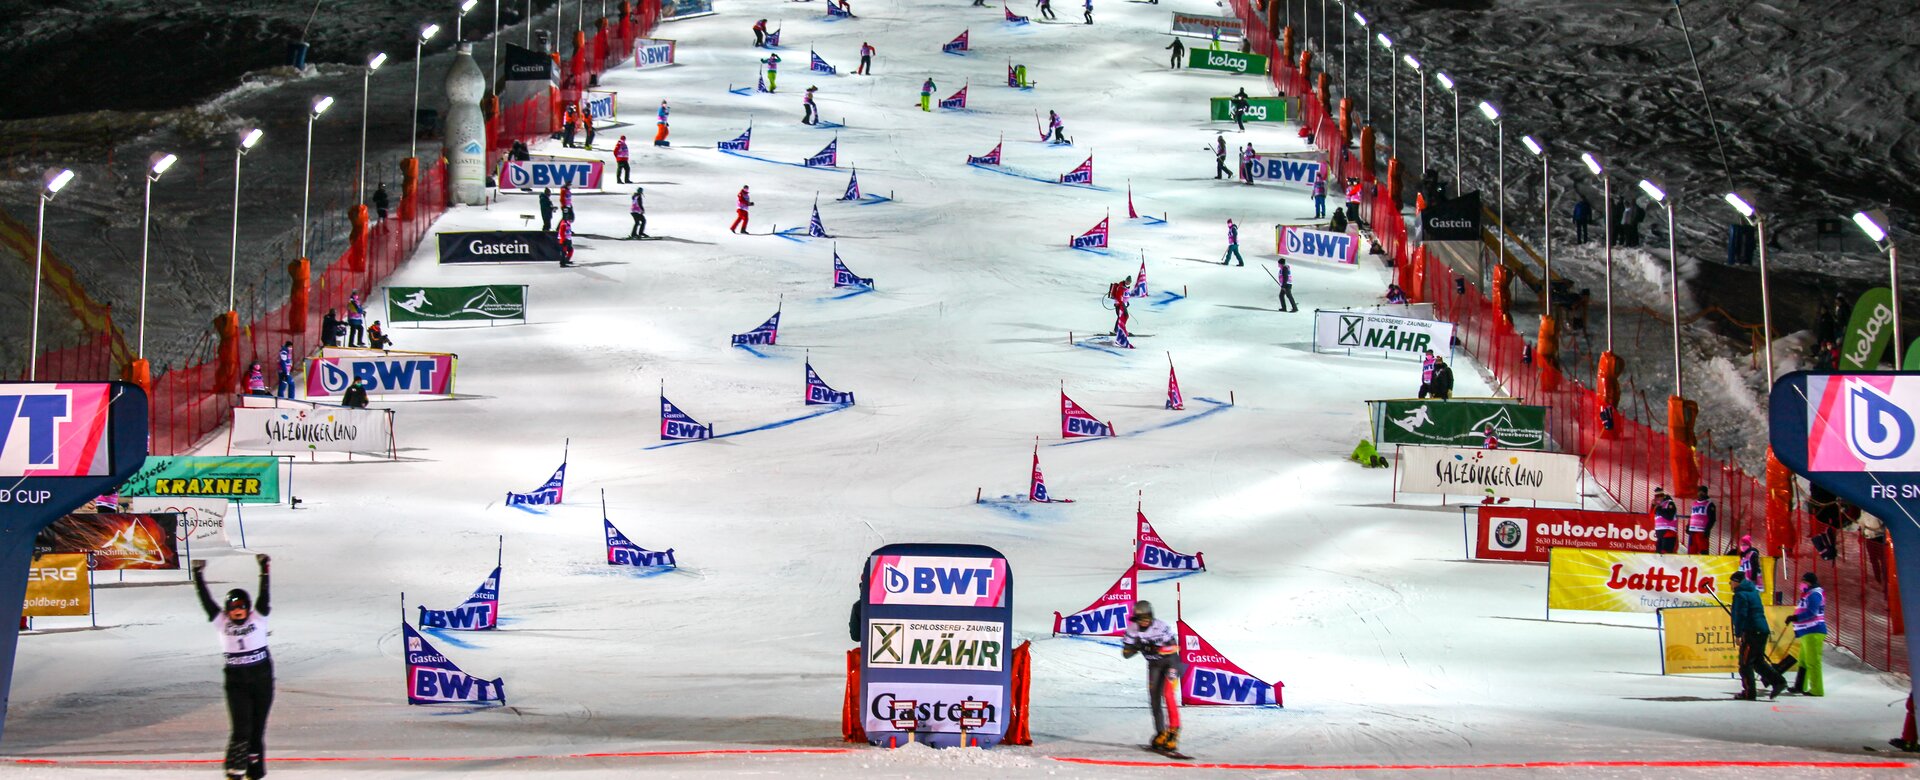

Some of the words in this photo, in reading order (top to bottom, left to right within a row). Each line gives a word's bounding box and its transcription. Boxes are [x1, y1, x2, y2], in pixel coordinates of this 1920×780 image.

[647, 46, 670, 65] BWT
[1207, 51, 1247, 71] kelag
[512, 64, 544, 72] Gastein
[591, 96, 613, 119] BWT
[532, 163, 590, 187] BWT
[1064, 171, 1089, 183] BWT
[1268, 160, 1320, 183] BWT
[1429, 217, 1472, 229] Gastein
[469, 239, 530, 255] Gastein
[1074, 234, 1104, 247] BWT
[1303, 235, 1351, 260] BWT
[1367, 316, 1404, 326] SCHLOSSEREI
[1406, 320, 1433, 329] ZAUNBAU
[738, 331, 772, 345] BWT
[1364, 325, 1431, 353] NÄHR
[1845, 303, 1892, 368] kelag
[353, 360, 437, 391] BWT
[811, 387, 849, 403] BWT
[265, 419, 334, 444] SALZBURGER
[333, 421, 357, 441] LAND
[666, 421, 708, 438] BWT
[1068, 417, 1109, 436] BWT
[1436, 461, 1512, 488] SALZBURGER
[1514, 462, 1543, 488] LAND
[155, 477, 261, 495] KRAXNER
[1871, 485, 1897, 499] FIS
[16, 490, 51, 504] CUP
[513, 490, 558, 504] BWT
[179, 517, 223, 528] GRÄTZHÖHE
[1536, 521, 1658, 542] autoschobe
[1536, 537, 1551, 545] 5630
[1563, 539, 1598, 548] Hofgastein
[1609, 541, 1625, 549] 5500
[1626, 542, 1657, 551] Bischofsh
[614, 548, 670, 567] BWT
[1144, 545, 1195, 569] BWT
[914, 567, 992, 595] BWT
[1606, 563, 1716, 594] Lattella
[23, 597, 79, 610] goldberg.at
[1640, 595, 1672, 608] frucht
[1670, 597, 1680, 607] &
[430, 605, 490, 629] BWT
[1066, 604, 1128, 634] BWT
[910, 623, 961, 632] SCHLOSSEREI
[966, 625, 1002, 633] ZAUNBAU
[409, 654, 447, 664] Gastein
[909, 633, 1001, 667] NÄHR
[1187, 651, 1226, 664] Gastein
[415, 669, 492, 701] BWT
[1193, 668, 1272, 705] BWT
